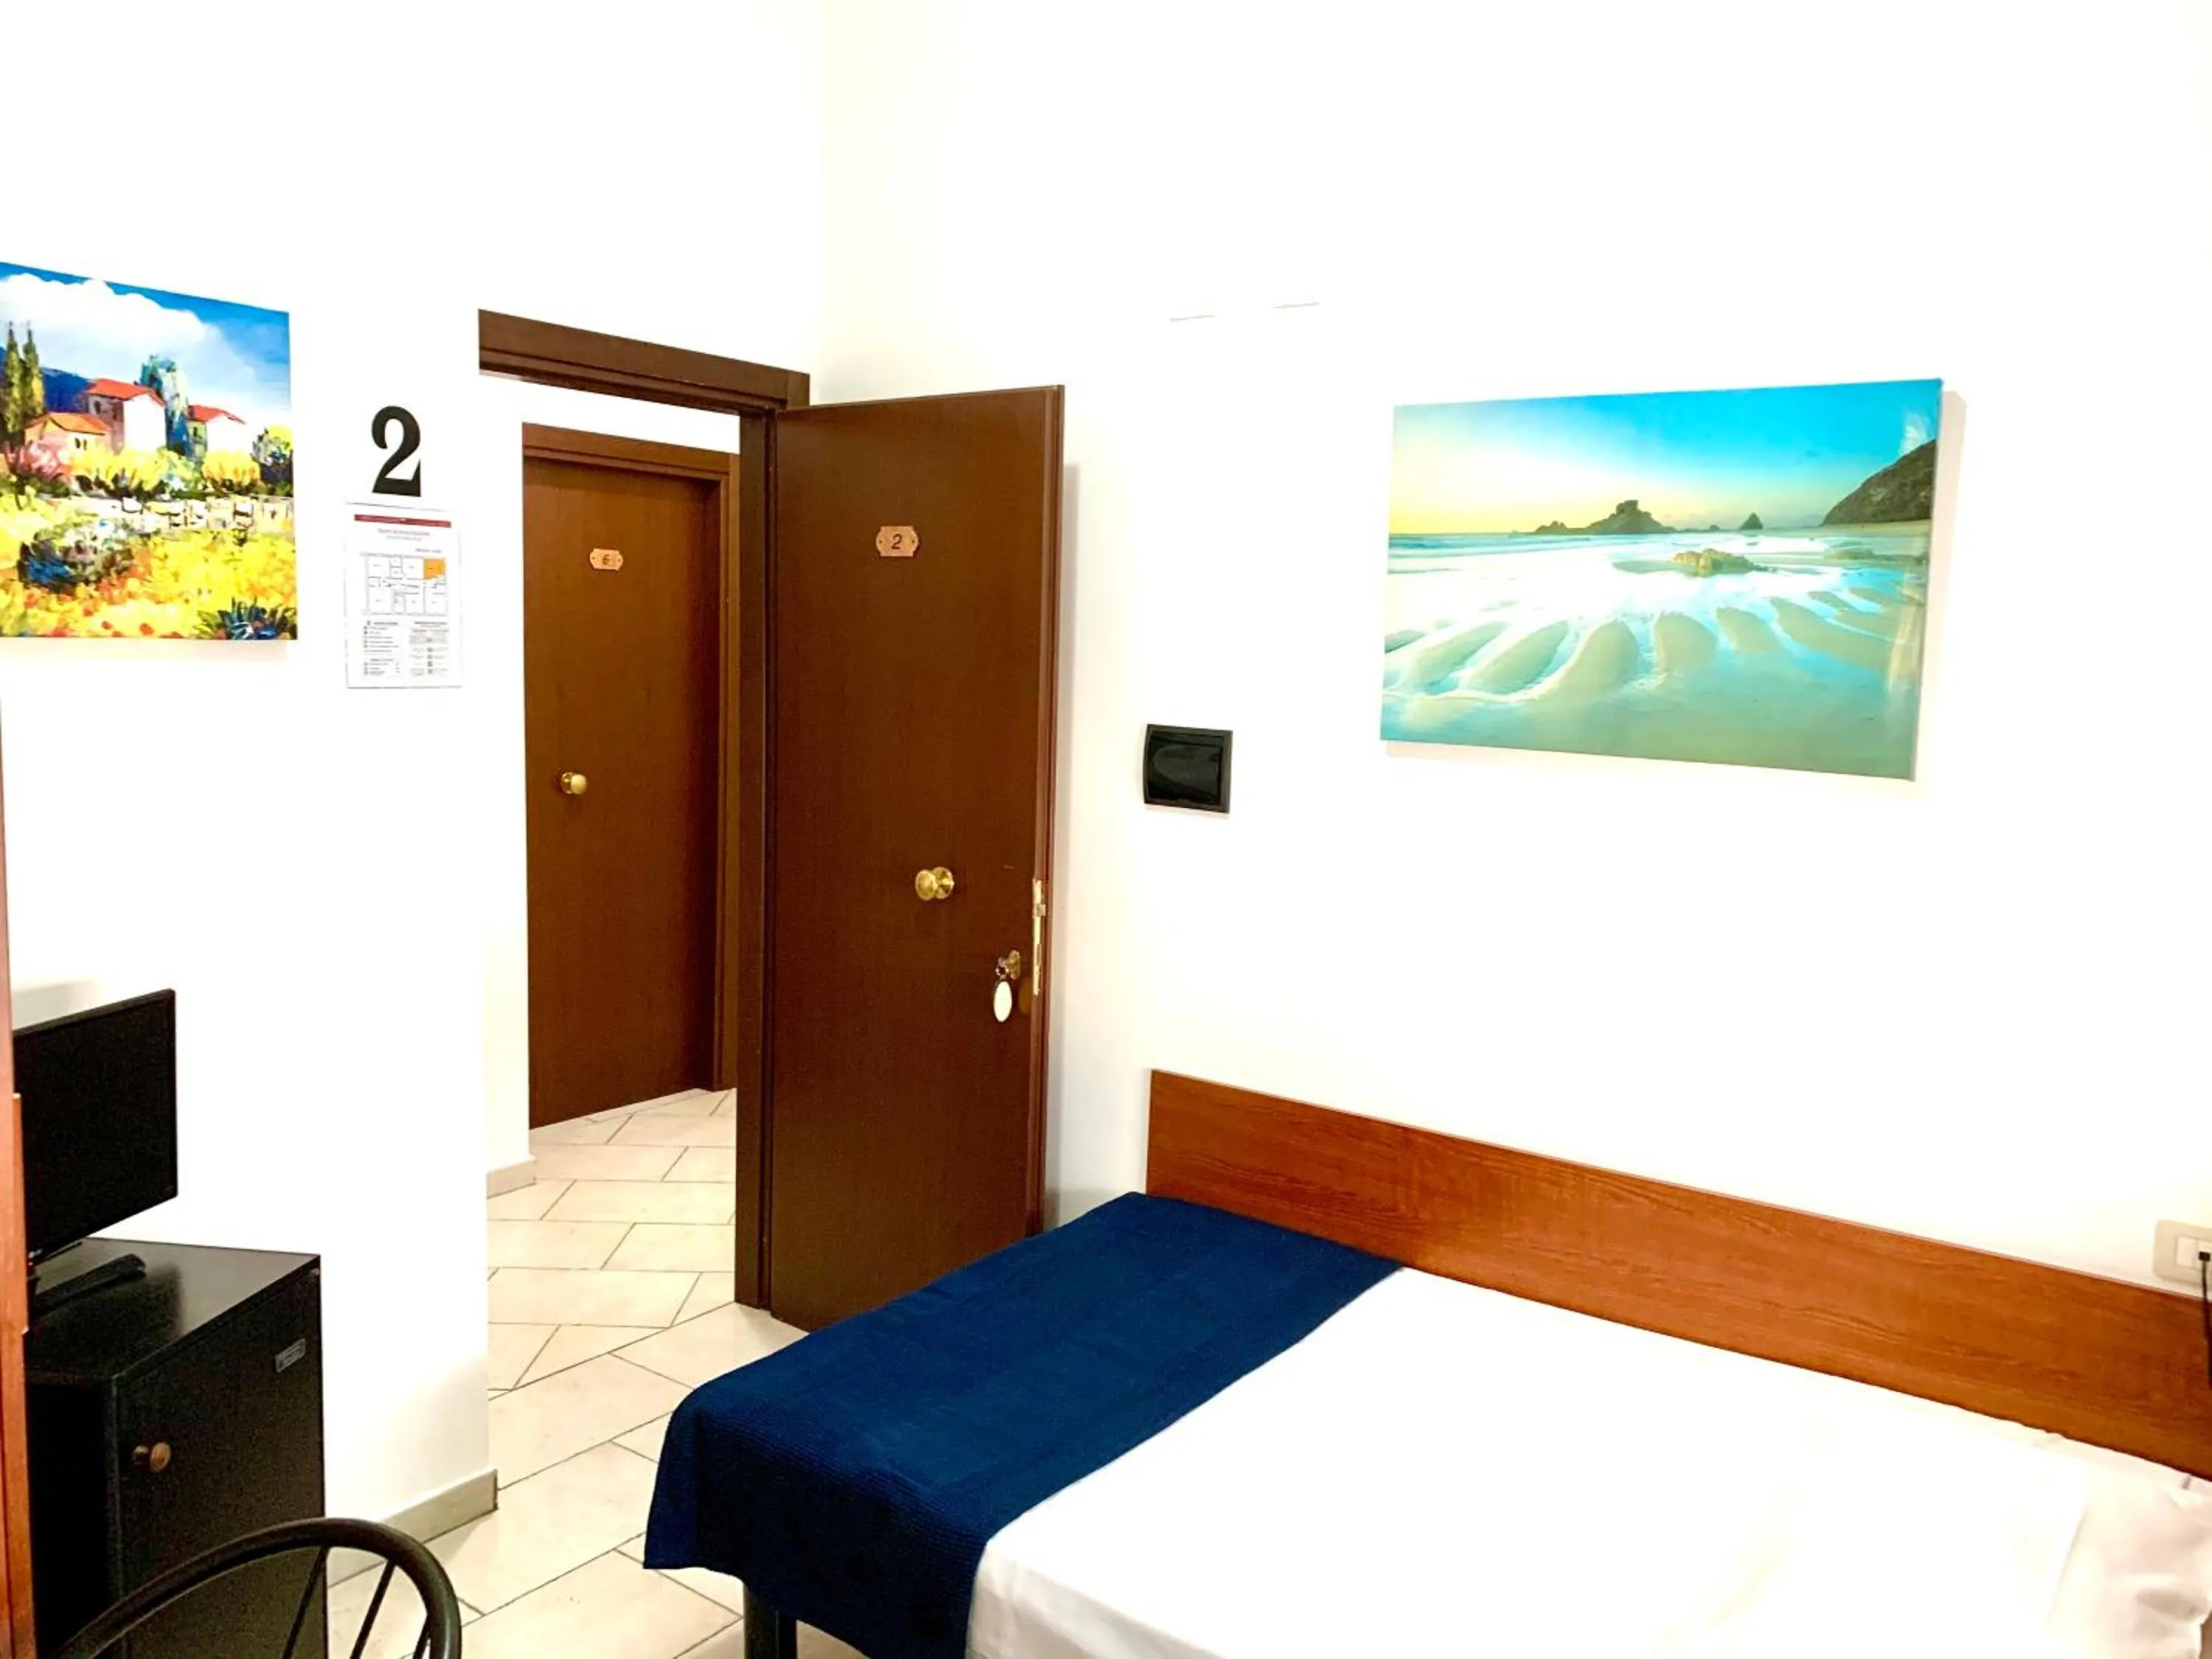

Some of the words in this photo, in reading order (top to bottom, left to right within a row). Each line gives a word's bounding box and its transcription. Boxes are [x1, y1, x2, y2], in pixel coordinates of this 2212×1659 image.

[372, 406, 421, 498] 2
[891, 533, 902, 549] 2
[602, 554, 610, 565] 6
